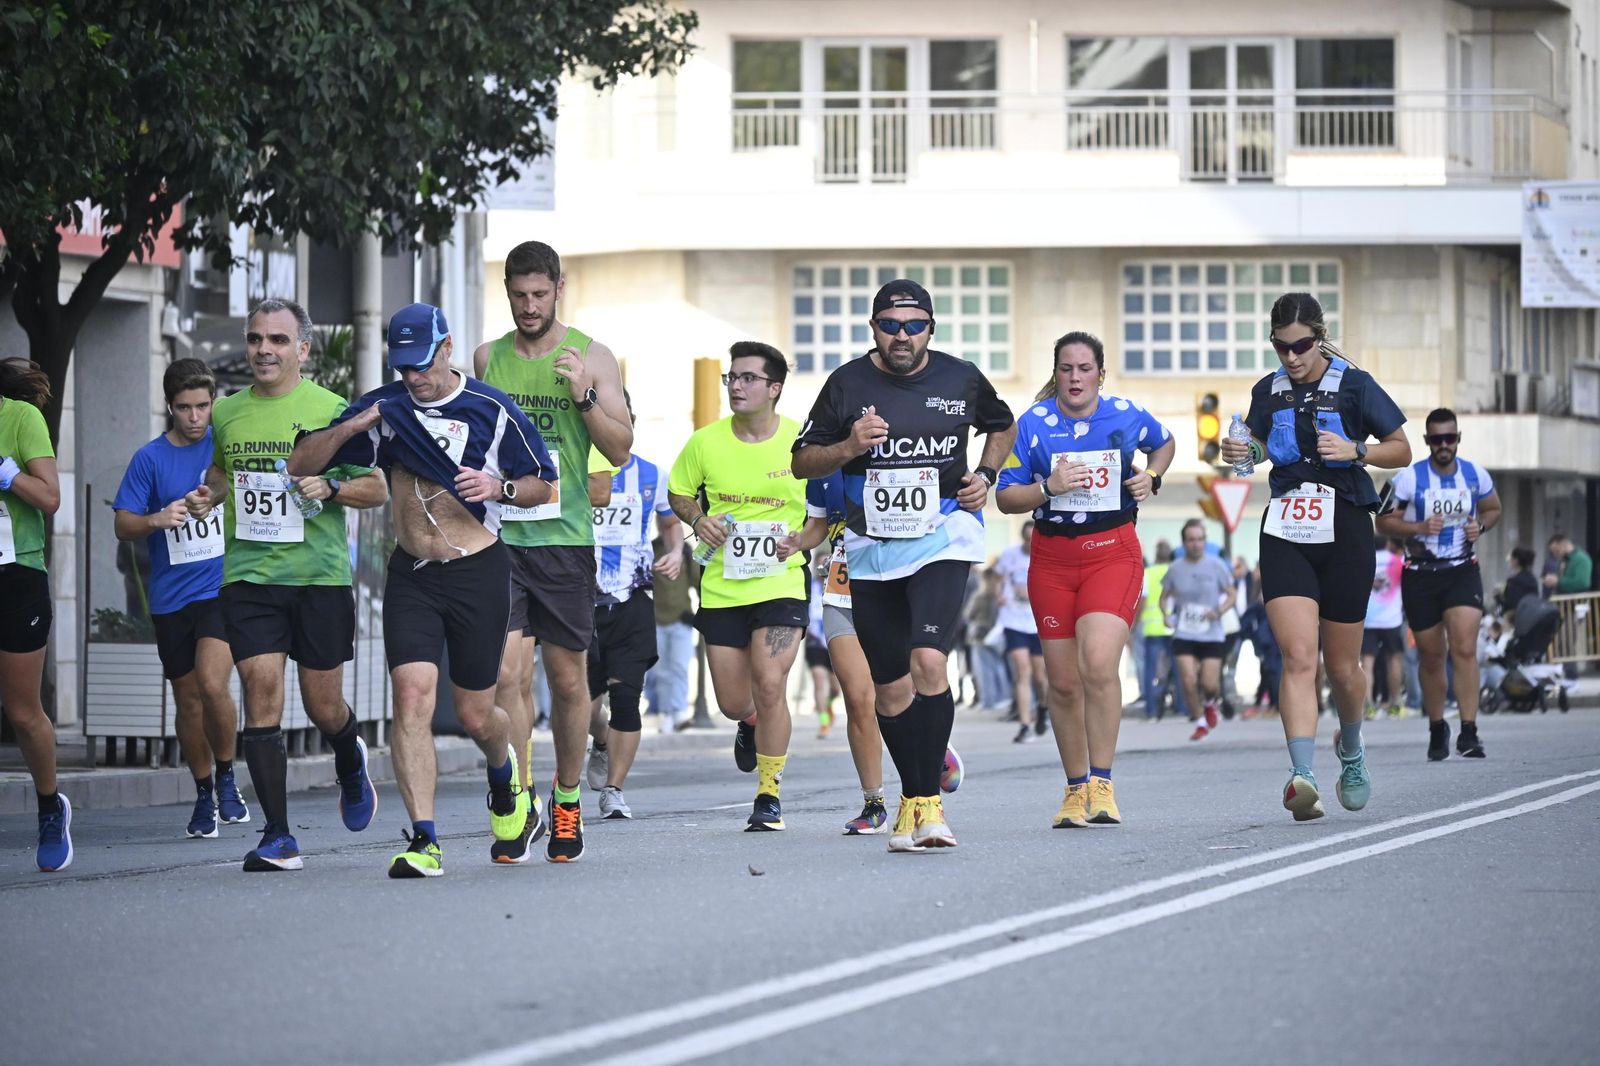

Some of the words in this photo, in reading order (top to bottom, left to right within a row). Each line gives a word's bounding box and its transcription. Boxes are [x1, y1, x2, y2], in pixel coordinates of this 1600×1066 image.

[448, 422, 464, 436] 2K
[224, 442, 294, 455] C.D.RUNNIN
[1102, 452, 1116, 462] 2K
[232, 458, 288, 472] san
[238, 474, 249, 485] 2K
[918, 470, 934, 481] 2K
[1081, 466, 1109, 490] 63
[244, 490, 287, 516] 951
[874, 487, 926, 512] 940
[1069, 498, 1098, 506] Huelva
[505, 506, 538, 515] Huelva
[1281, 498, 1323, 521] 755
[1433, 500, 1464, 514] 804
[592, 508, 632, 525] 872
[170, 516, 221, 542] 1101
[250, 526, 279, 536] Huelva
[732, 523, 738, 533] K
[770, 523, 784, 533] 2K
[883, 523, 916, 532] Huelva
[1282, 531, 1312, 539] Huelva
[184, 548, 212, 558] Huelva
[732, 537, 776, 558] 970
[738, 566, 766, 574] Huelva
[836, 564, 848, 585] 5
